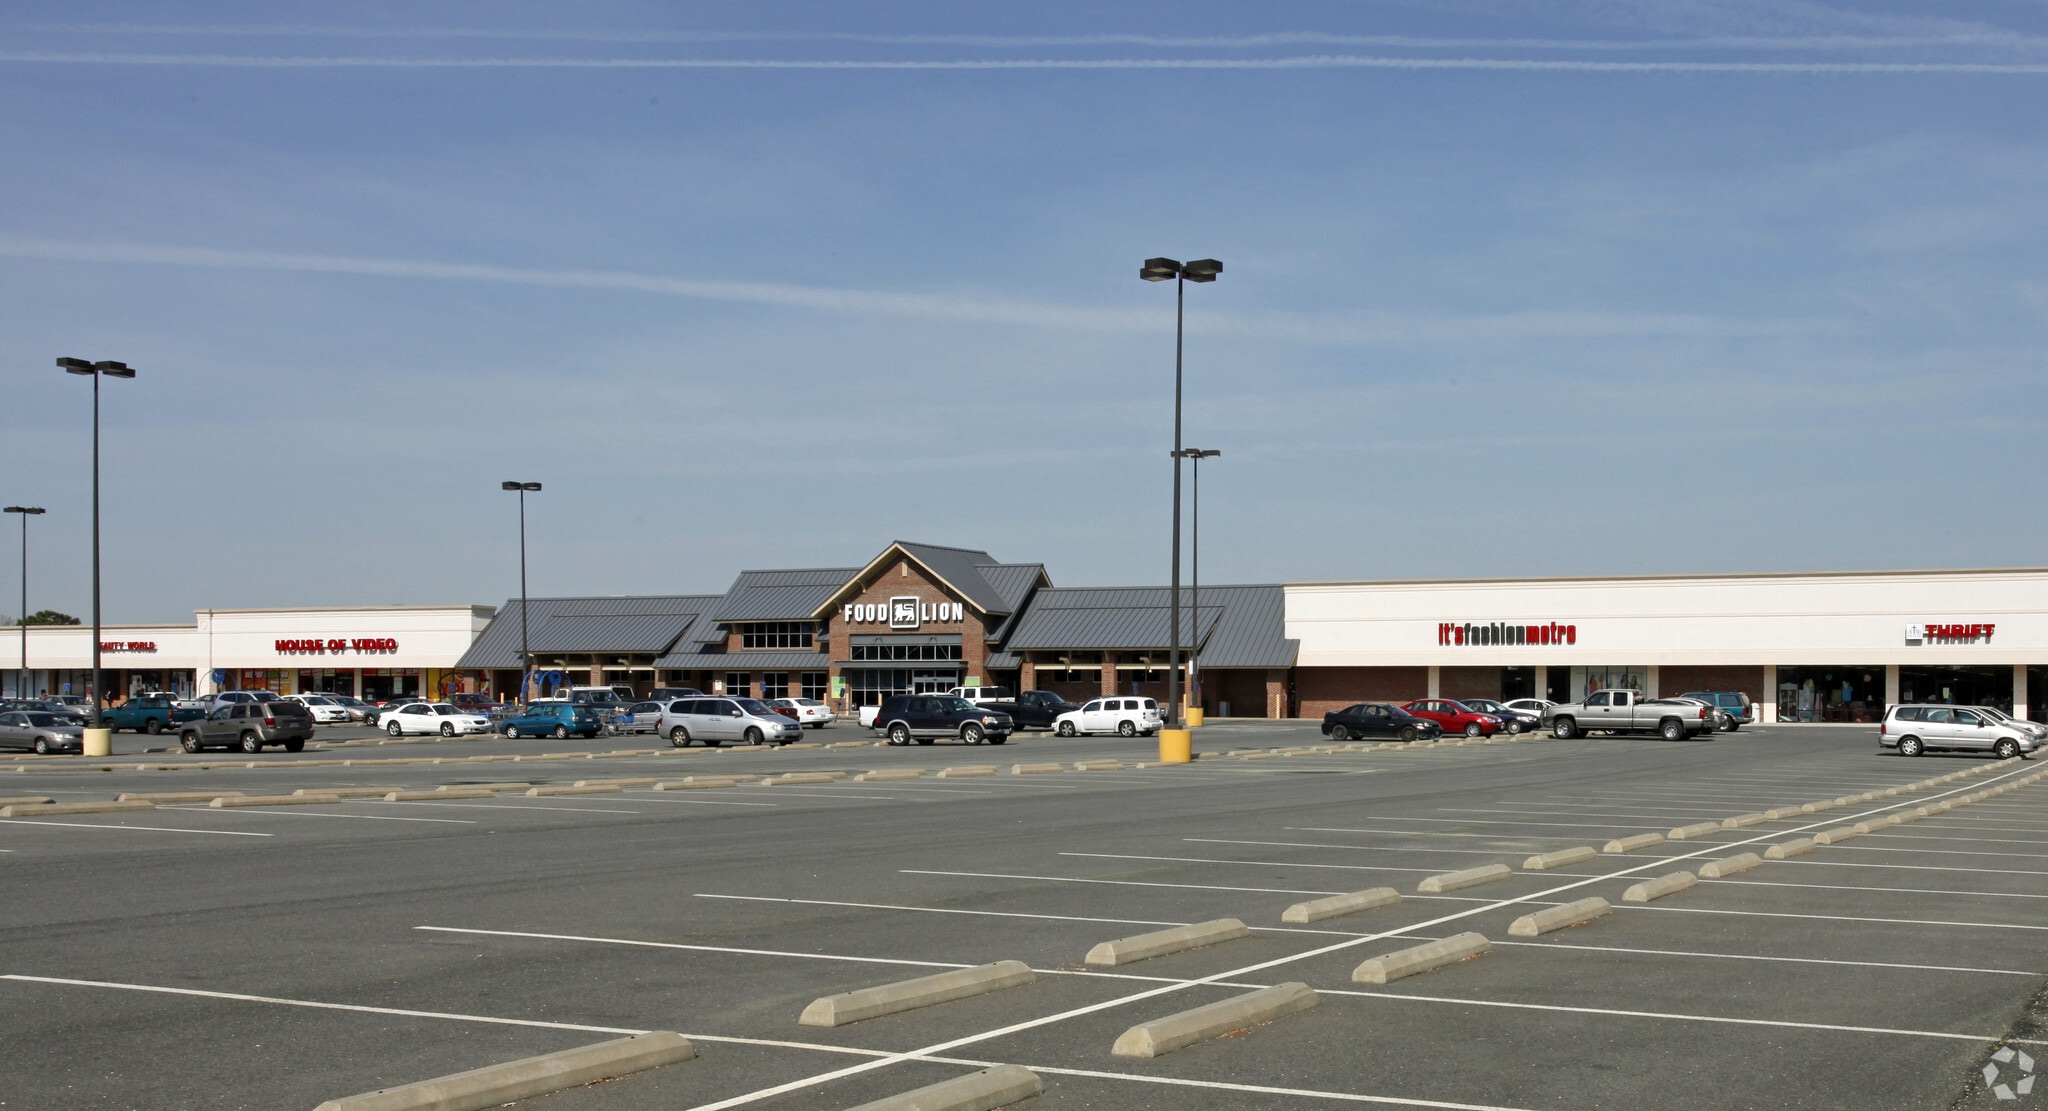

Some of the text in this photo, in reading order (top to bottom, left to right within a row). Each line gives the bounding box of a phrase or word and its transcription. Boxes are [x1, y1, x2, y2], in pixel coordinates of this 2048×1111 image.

[844, 602, 964, 622] FOOD LION
[1925, 624, 1996, 638] THRIFT
[127, 641, 155, 651] WORLD
[275, 638, 396, 651] HOUSE OF VIDEO
